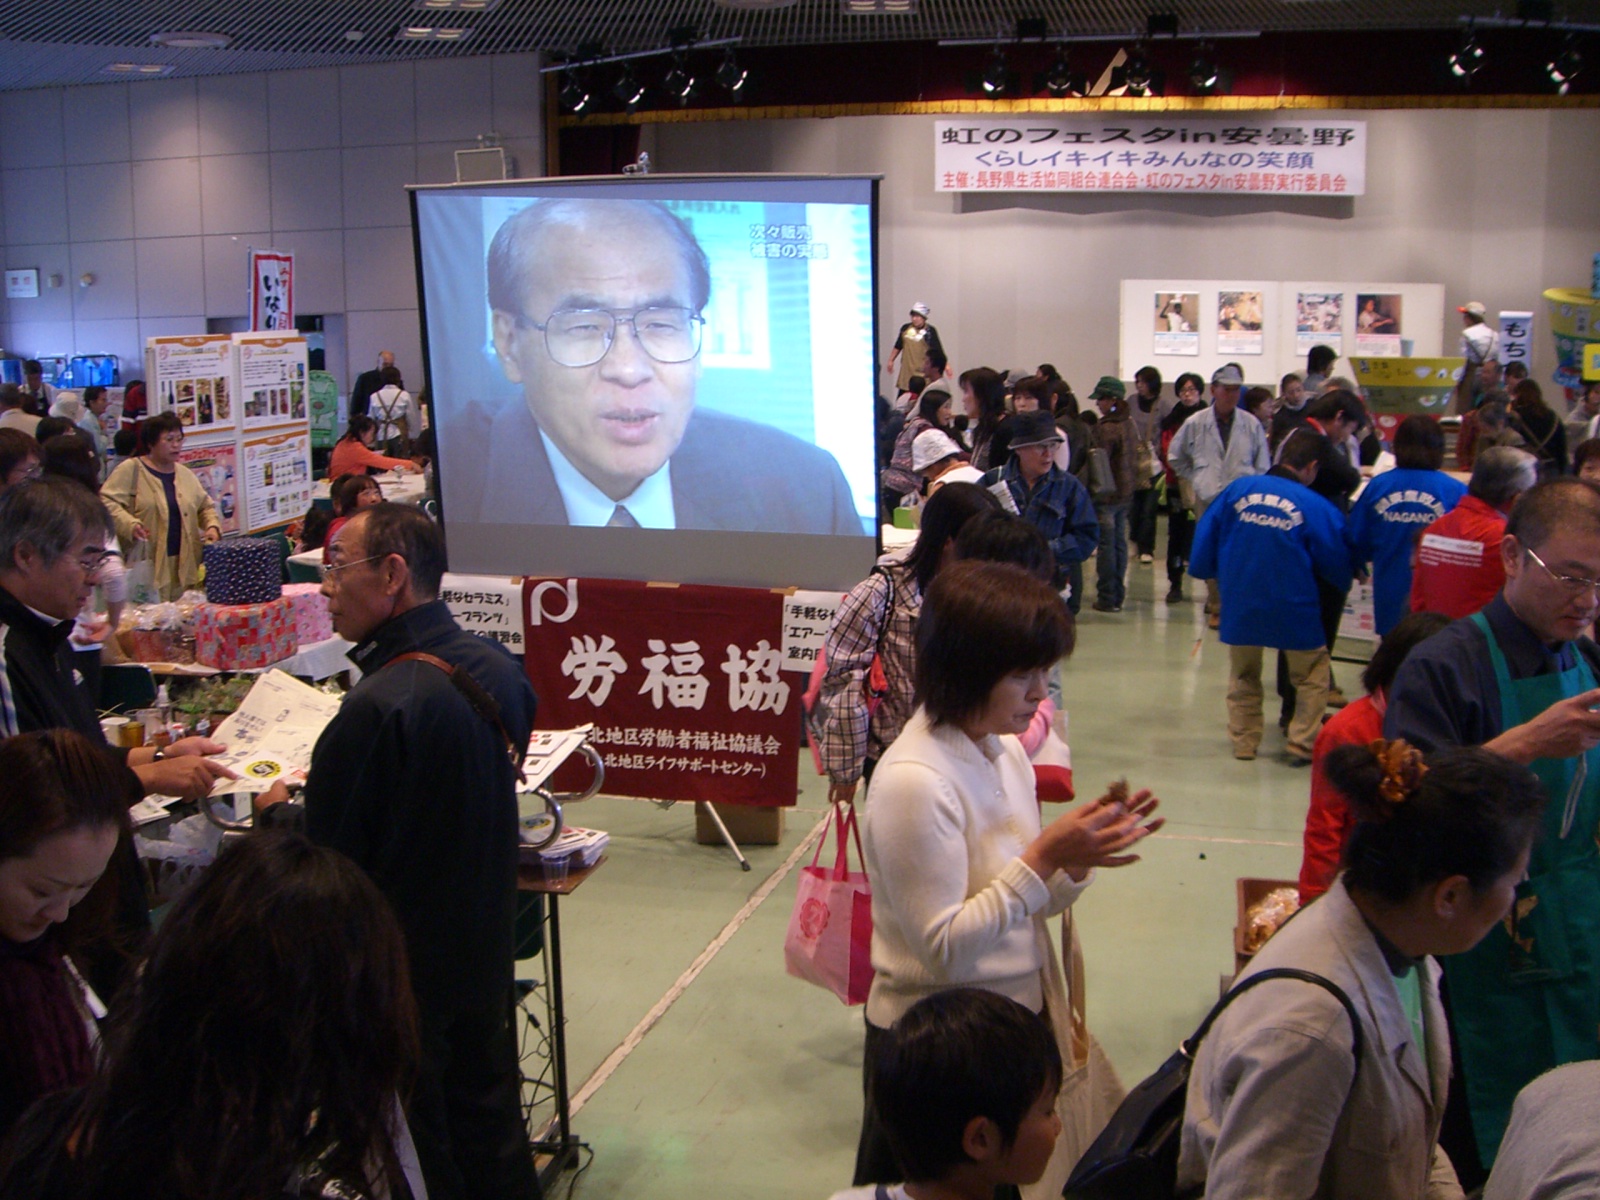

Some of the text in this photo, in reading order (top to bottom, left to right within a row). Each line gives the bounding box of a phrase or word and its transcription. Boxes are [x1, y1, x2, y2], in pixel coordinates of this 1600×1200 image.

[942, 126, 1355, 146] 虹のフェスタin安曇野
[976, 151, 1314, 169] くらしイキイキみんなの笑顔
[1239, 511, 1293, 531] NAGANO
[1383, 511, 1436, 523] NAGANO
[437, 590, 509, 606] 軽なセラミス」
[784, 624, 828, 639] 「エアー
[560, 633, 791, 716] 労福協
[576, 725, 782, 756] 北地区労働者福祉協議会
[585, 753, 766, 779] (北地区ライフサポートセンター)
